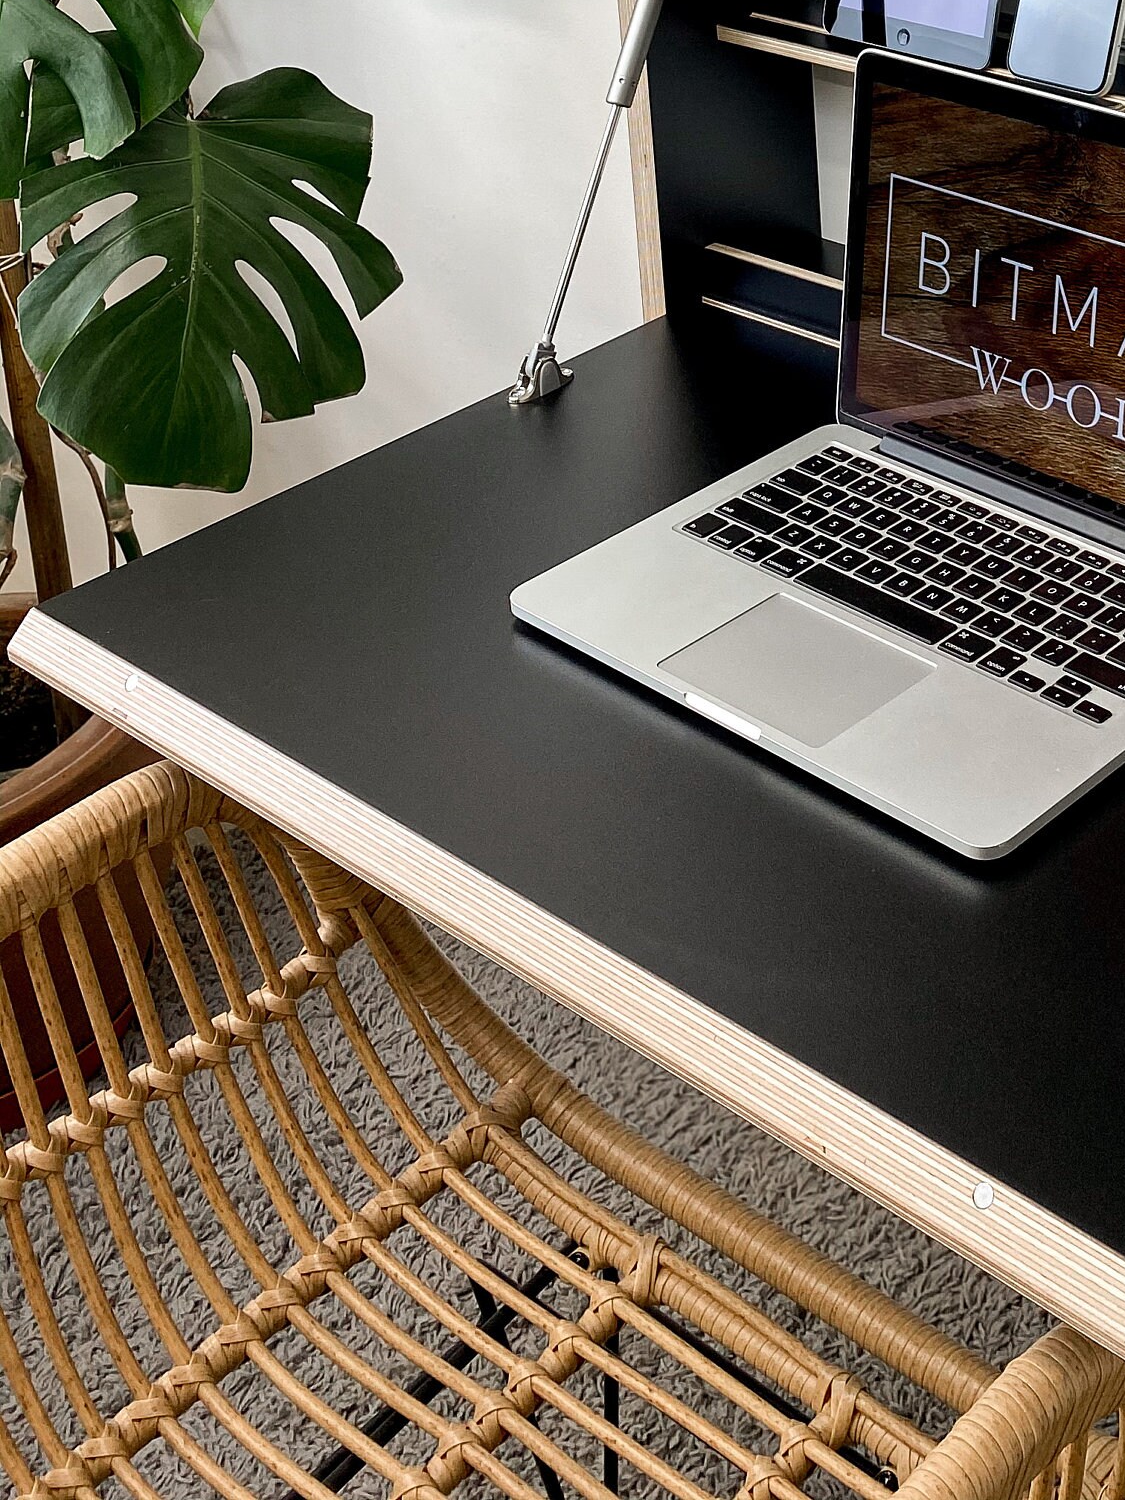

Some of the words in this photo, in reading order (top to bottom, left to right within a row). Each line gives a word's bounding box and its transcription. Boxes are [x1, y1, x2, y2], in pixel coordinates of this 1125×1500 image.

[750, 491, 762, 499] caps
[713, 535, 732, 544] control
[739, 547, 755, 556] option
[766, 558, 792, 573] command
[945, 642, 974, 657] command
[986, 661, 1005, 672] option
